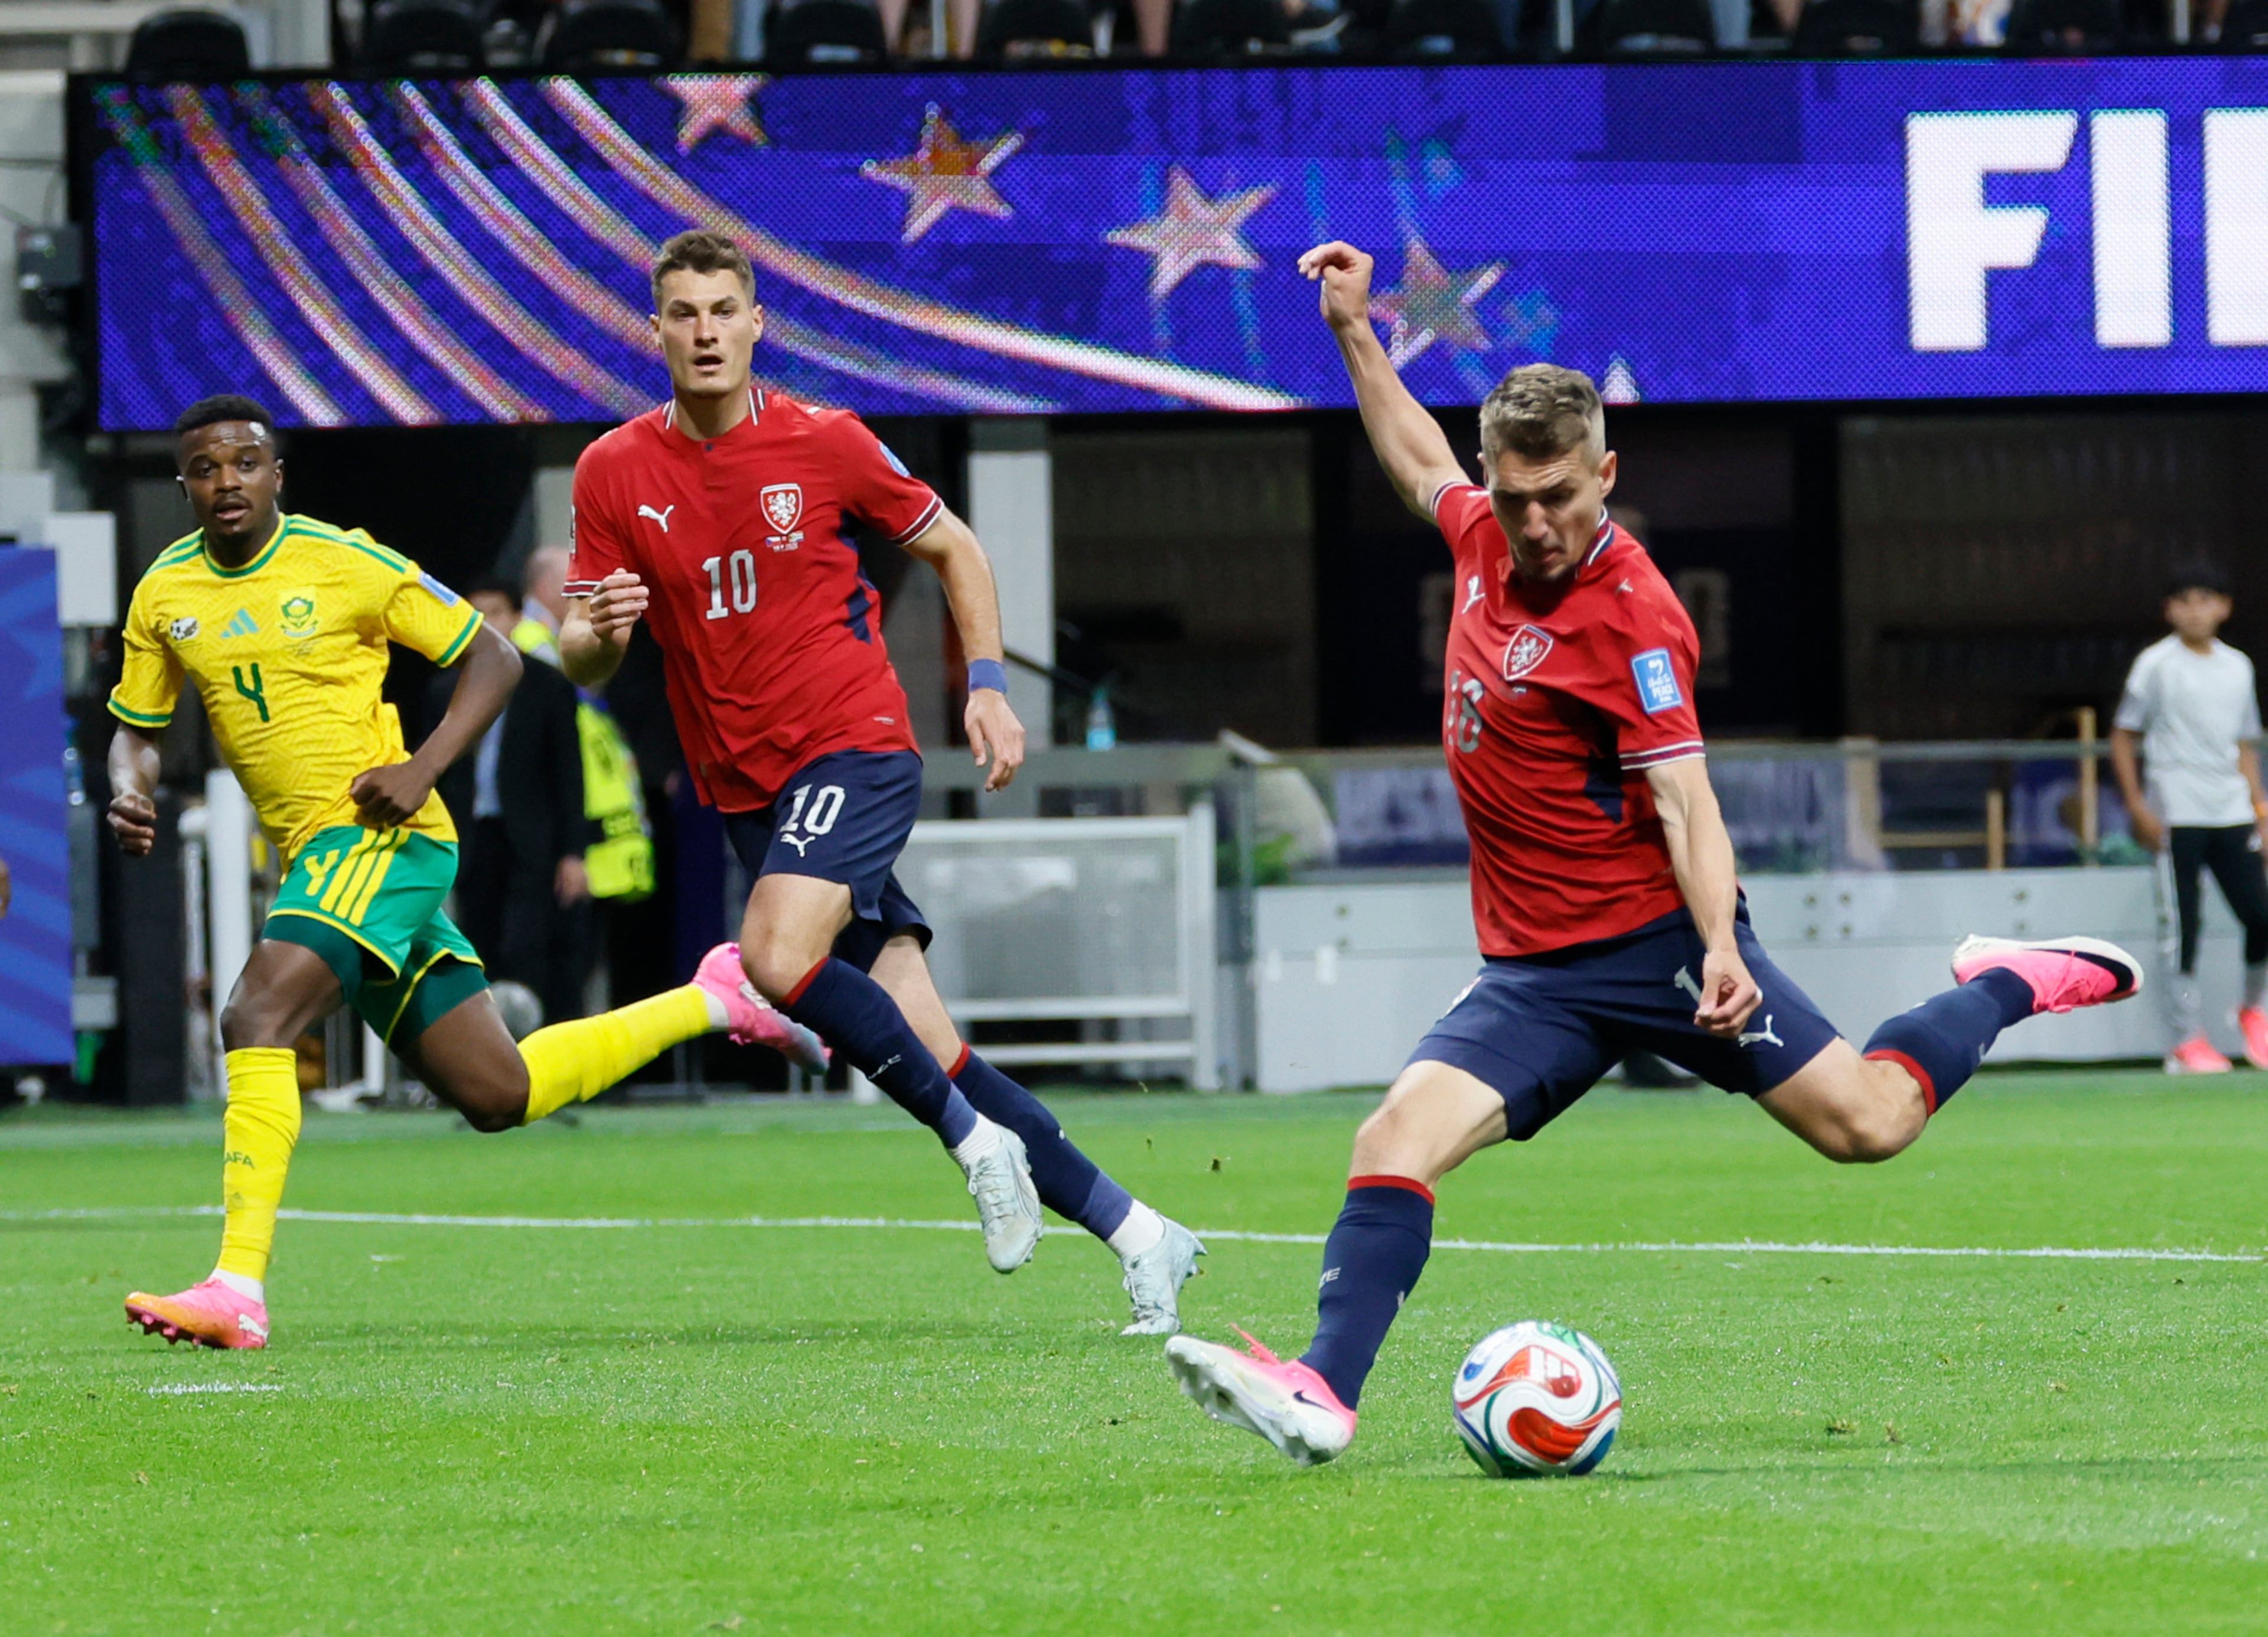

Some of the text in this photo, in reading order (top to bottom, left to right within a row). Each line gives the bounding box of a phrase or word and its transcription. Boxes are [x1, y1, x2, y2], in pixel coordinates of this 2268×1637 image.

[702, 549, 757, 620] 10
[232, 662, 269, 722] 4
[780, 784, 845, 835] 10
